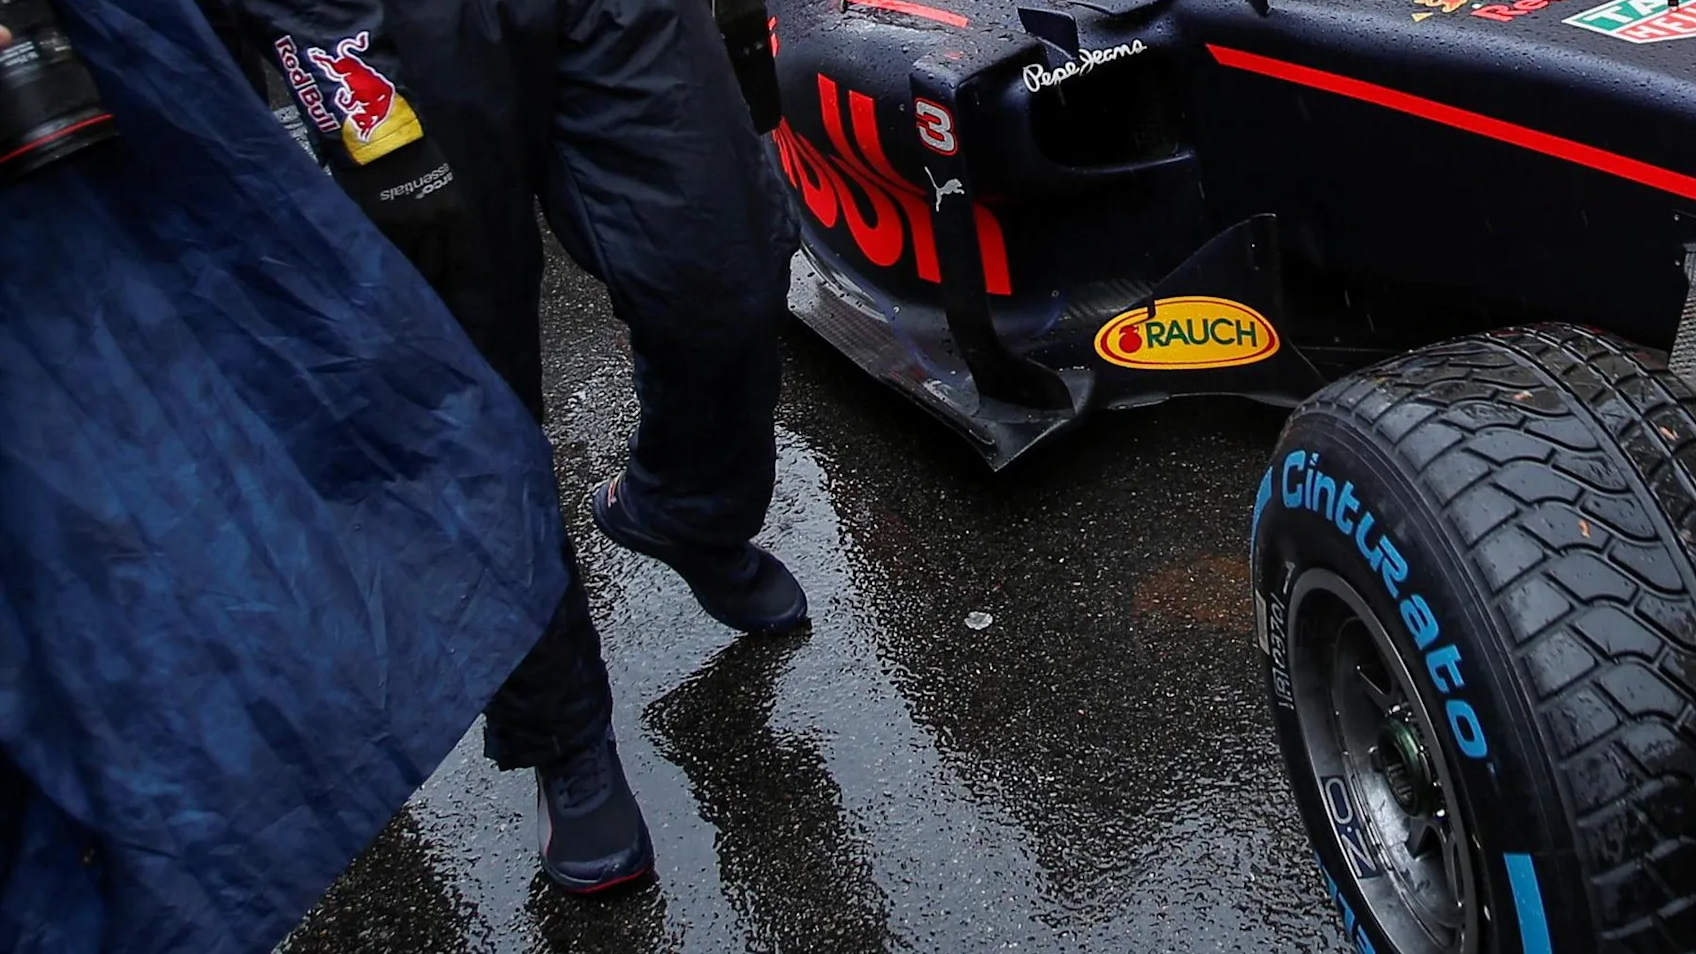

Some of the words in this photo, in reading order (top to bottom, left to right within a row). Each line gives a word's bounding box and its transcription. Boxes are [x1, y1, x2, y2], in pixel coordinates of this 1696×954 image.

[275, 35, 317, 89] Red
[300, 85, 341, 134] Bull
[1022, 62, 1081, 92] Pepe
[1079, 38, 1147, 75] Jeans
[915, 98, 957, 156] 3
[1145, 317, 1259, 350] RAUCH
